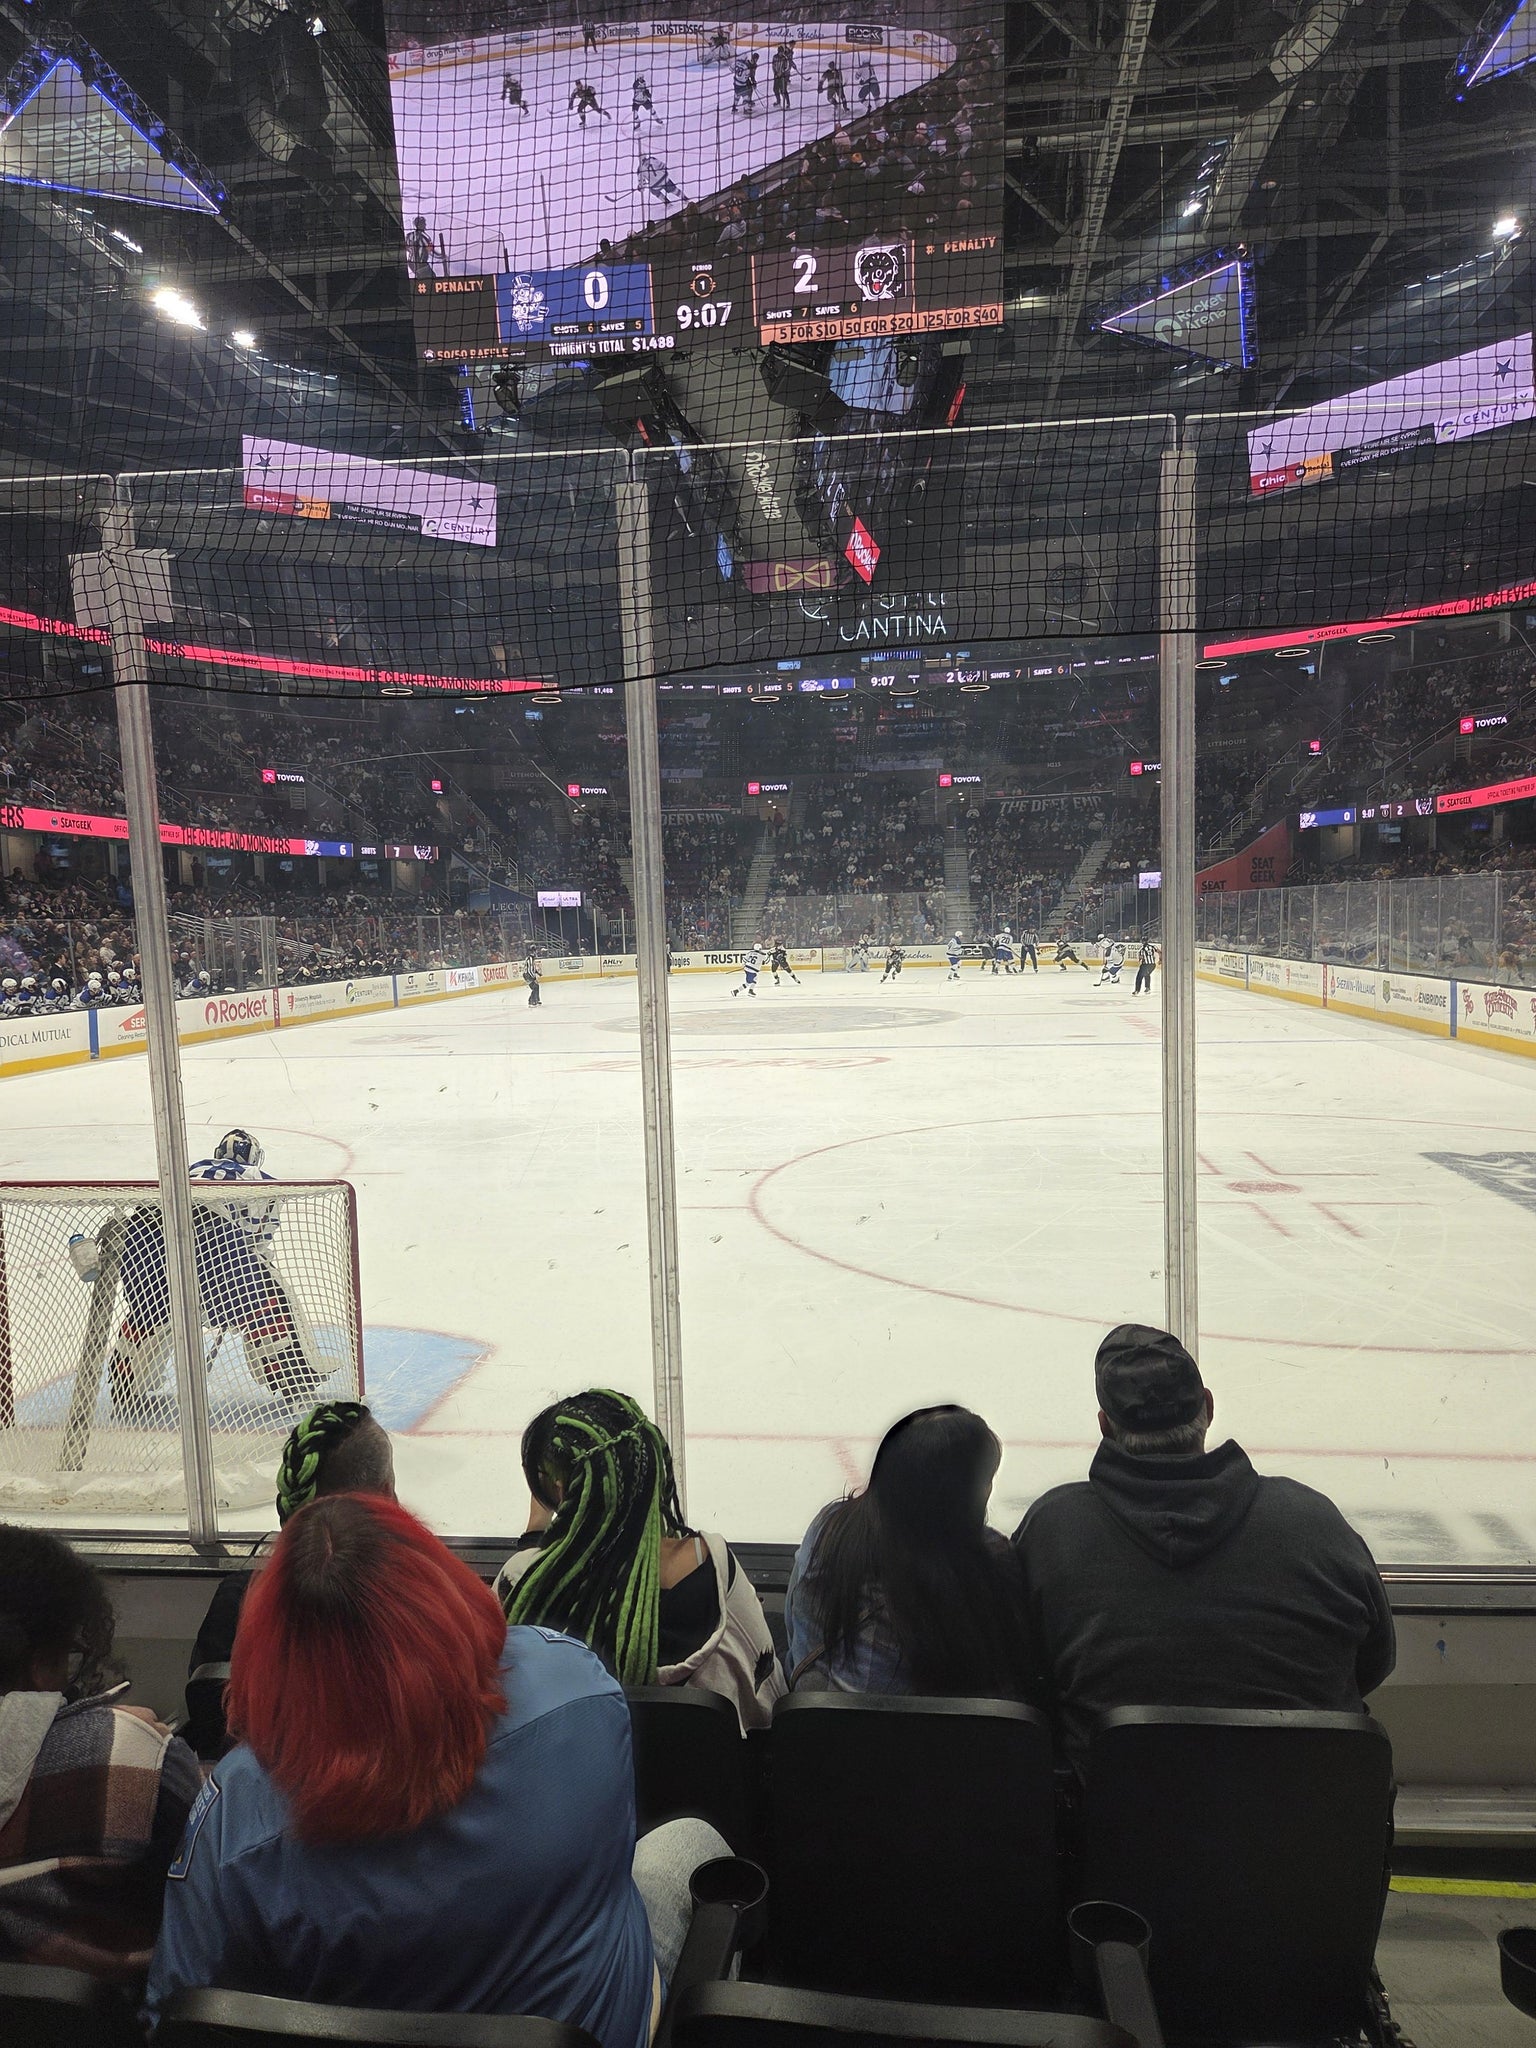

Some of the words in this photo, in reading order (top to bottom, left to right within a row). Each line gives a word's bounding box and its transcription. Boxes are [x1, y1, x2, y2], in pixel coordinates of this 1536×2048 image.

[944, 236, 997, 253] PENALTY
[691, 263, 712, 272] PERIOD
[793, 254, 819, 294] 2
[434, 280, 484, 293] PENALTY
[584, 271, 609, 310] 0
[766, 309, 792, 319] SHOTS
[802, 308, 809, 318] 7
[815, 305, 841, 316] SAVES
[851, 303, 858, 314] 6
[1175, 294, 1227, 322] Rocket
[677, 301, 732, 330] 9:07
[1186, 308, 1227, 333] Arena
[553, 324, 579, 335] SHOTS
[588, 323, 594, 333] 6
[601, 322, 625, 332] SAVES
[635, 320, 642, 330] 5
[780, 327, 788, 340] 5
[791, 325, 814, 339] FOR
[816, 322, 838, 338] $10
[845, 319, 861, 334] 50
[863, 317, 887, 333] FOR
[890, 315, 914, 331] $20
[923, 312, 944, 328] 125
[946, 310, 971, 325] FOR
[974, 308, 998, 323] $40
[549, 342, 596, 356] TONIGHT'S
[598, 340, 625, 353] TOTAL
[631, 335, 675, 351] $1,488
[437, 349, 468, 362] 50/50
[470, 347, 509, 360] RAFFLE
[1463, 393, 1528, 425] CENTURY
[1341, 454, 1371, 468] EVERYDAY
[1372, 450, 1389, 461] HERO
[1259, 474, 1286, 488] Ohio
[443, 522, 491, 536] CENTURY
[1469, 594, 1491, 613] THE
[840, 614, 946, 641] CANTINA
[1317, 627, 1349, 639] SEATGEEK
[144, 639, 186, 659] NSTERS
[946, 672, 954, 682] 2
[990, 671, 1010, 680] SHOTS
[1034, 668, 1052, 676] SAVES
[1057, 665, 1064, 673] 6
[364, 671, 381, 683] THE
[384, 671, 443, 688] CLEVELAND
[444, 677, 503, 692] MONSTERS
[831, 678, 839, 689] 0
[871, 675, 895, 687] 9:07
[722, 686, 742, 694] SHOTS
[746, 685, 753, 694] 6
[764, 684, 782, 692] SAVES
[787, 683, 793, 692] 5
[1475, 716, 1508, 728] TOYOTA
[1207, 738, 1247, 748] LITEHOUSE
[1143, 764, 1161, 772] TOYO
[276, 773, 305, 783] TOYOTA
[953, 776, 981, 784] TOYOTA
[581, 786, 607, 795] TOYOTA
[761, 783, 788, 792] TOYOTA
[1000, 800, 1028, 814] THE
[1446, 796, 1473, 808] SEATGEEK
[1343, 811, 1350, 821] 0
[1362, 808, 1375, 819] 9:07
[1397, 806, 1403, 815] 2
[661, 814, 694, 826] DEEP
[60, 816, 92, 832] SEATGEEK
[114, 824, 128, 833] OFFICI
[159, 829, 173, 839] ARTNER
[182, 827, 197, 846] THE
[198, 828, 246, 851] CLEVELAND
[247, 835, 290, 854] MONSTERS
[340, 845, 347, 855] 6
[361, 846, 376, 855] SHOTS
[393, 847, 400, 857] 7
[1252, 857, 1274, 870] SEAT
[1250, 870, 1276, 883] GEEK
[1201, 880, 1227, 891] SEAT
[1001, 936, 1010, 944] 20
[704, 953, 745, 964] TRUSTE
[483, 965, 509, 983] SEATGEEK
[1336, 976, 1376, 995] SHERWIN-WILLIAMS
[1419, 992, 1447, 1008] ENBRIDGE
[219, 995, 268, 1022] Rocket
